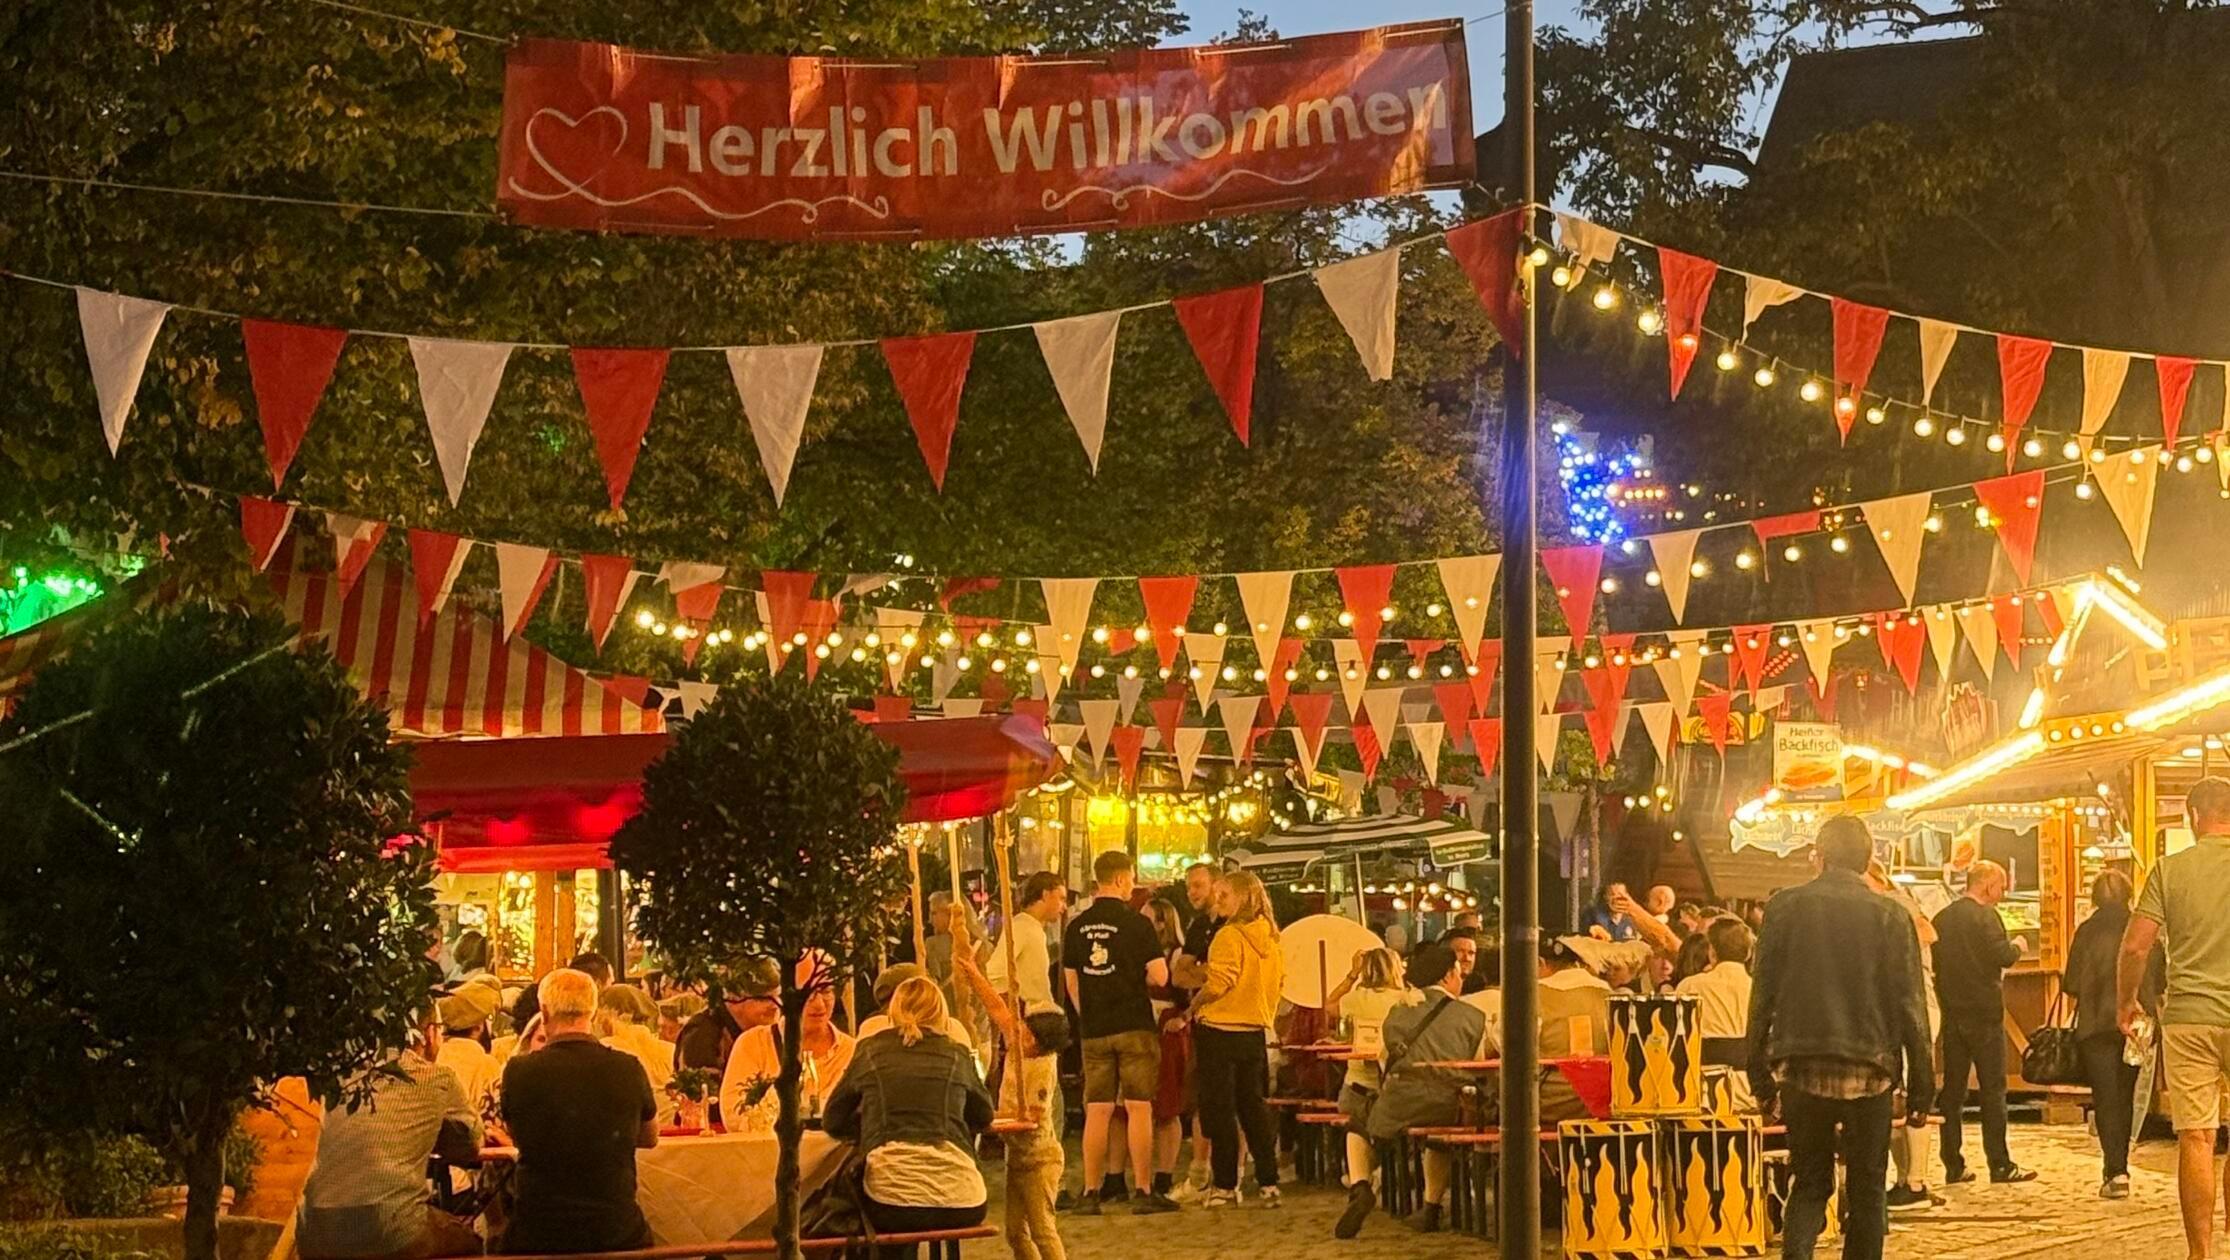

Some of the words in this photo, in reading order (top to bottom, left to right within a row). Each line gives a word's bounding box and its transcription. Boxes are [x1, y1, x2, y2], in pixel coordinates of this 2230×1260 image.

[647, 101, 959, 178] Herzlich
[983, 78, 1449, 174] Willkommen
[1779, 737, 1838, 752] Backfisch
